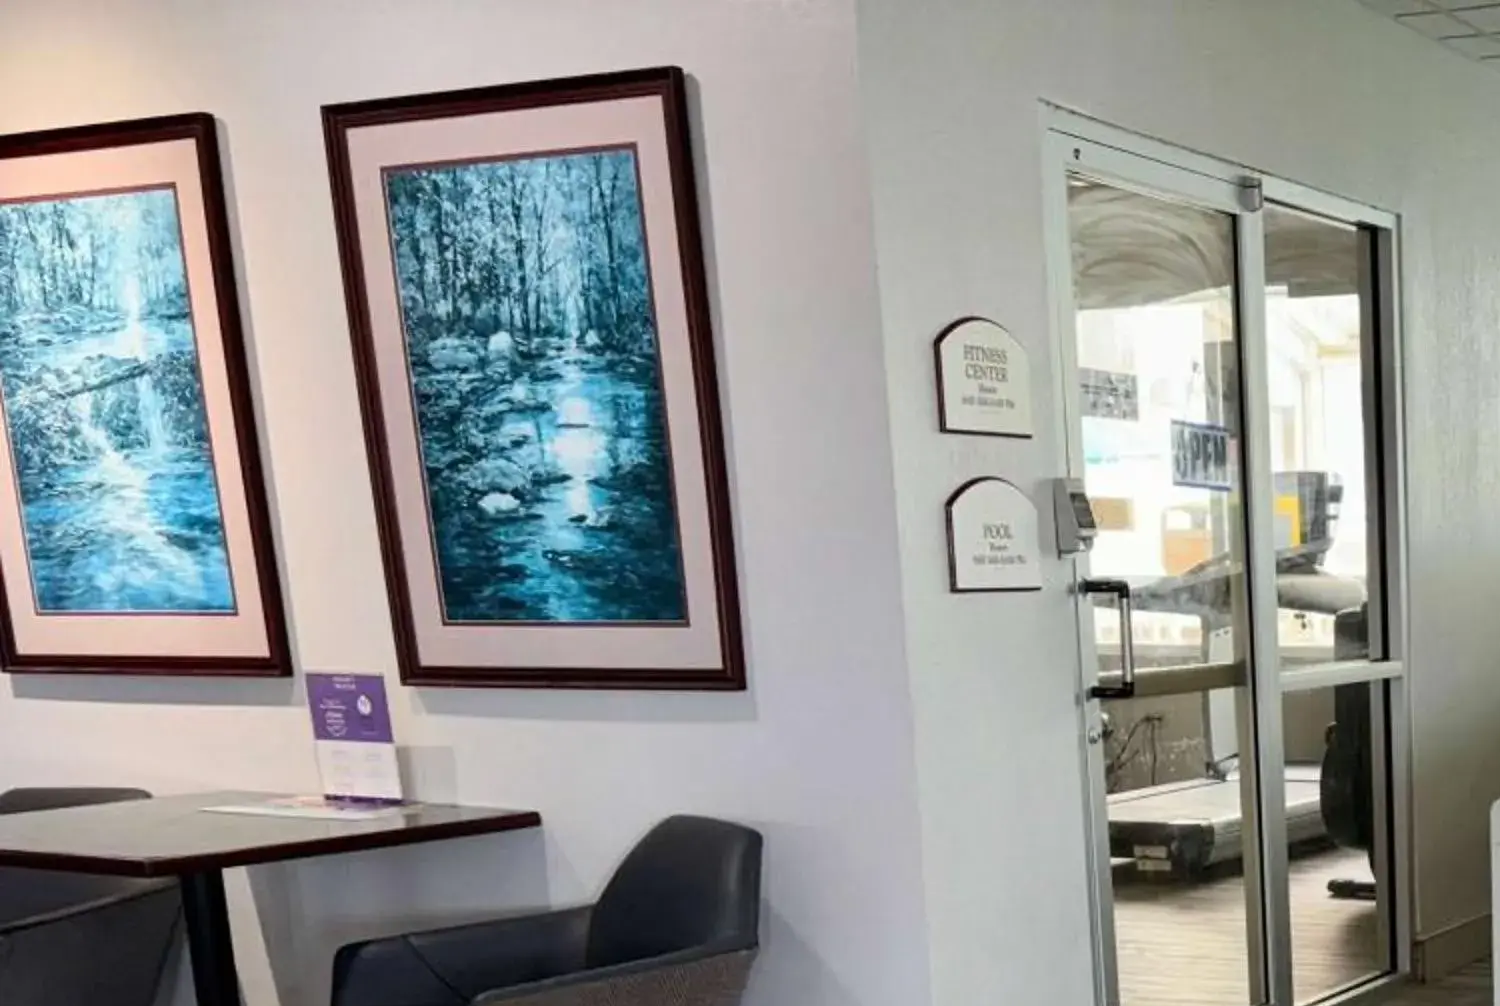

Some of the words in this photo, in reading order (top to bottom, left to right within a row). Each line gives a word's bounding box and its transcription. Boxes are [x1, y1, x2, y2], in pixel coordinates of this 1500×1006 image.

[963, 344, 1008, 364] FITNESS
[965, 363, 1009, 382] CENTER
[983, 522, 1013, 540] POOL
